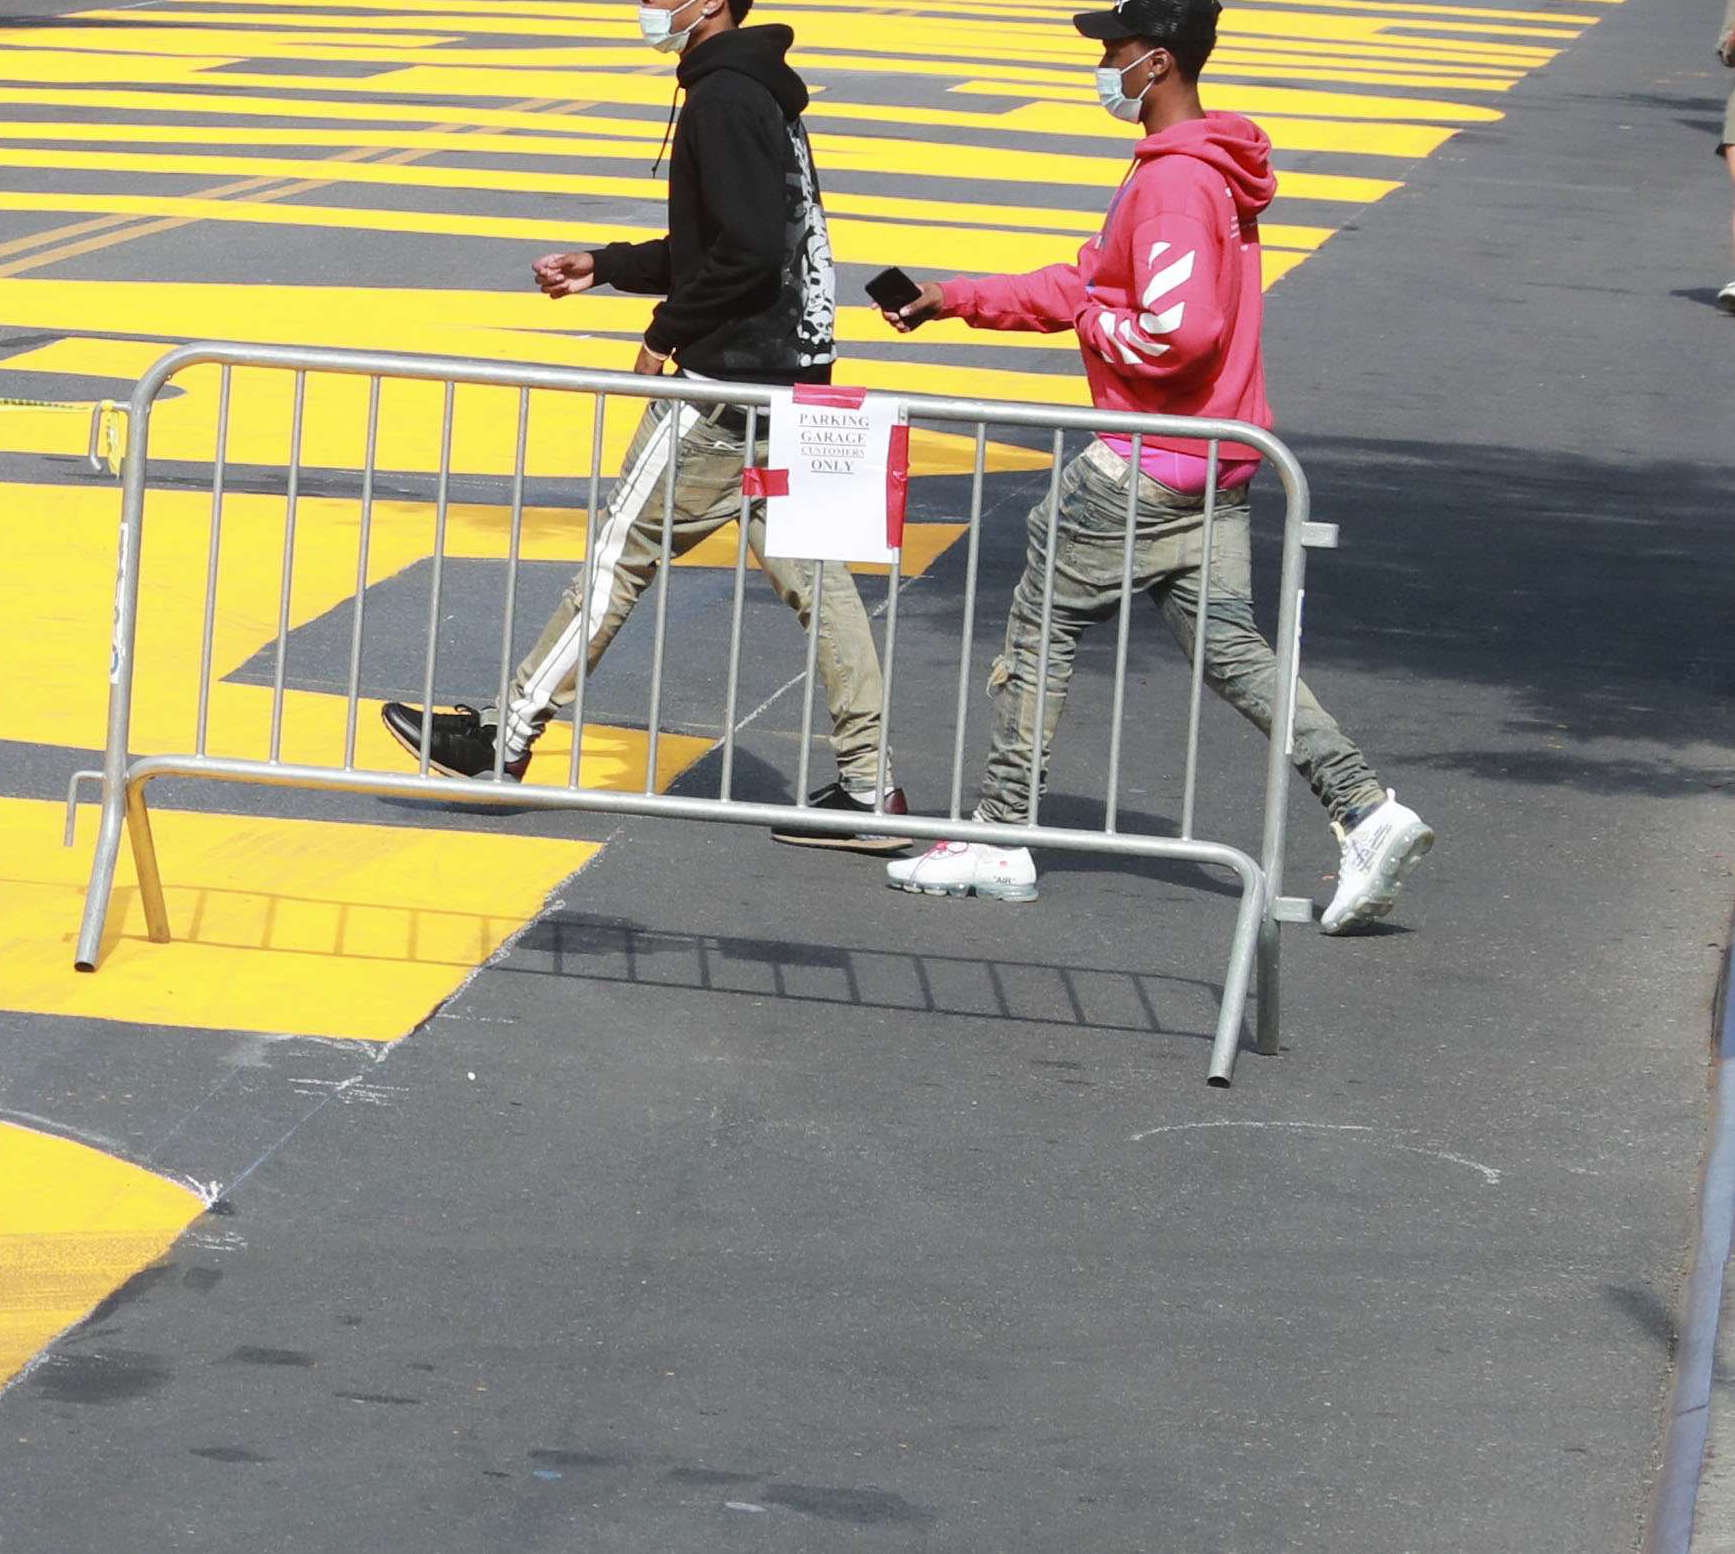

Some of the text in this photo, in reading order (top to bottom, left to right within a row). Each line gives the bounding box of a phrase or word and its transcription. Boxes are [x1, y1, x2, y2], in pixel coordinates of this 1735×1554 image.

[799, 413, 870, 428] PARKING
[800, 430, 866, 445] GARAGE
[801, 446, 865, 457] CUSTOMERS
[811, 459, 854, 472] ONLY
